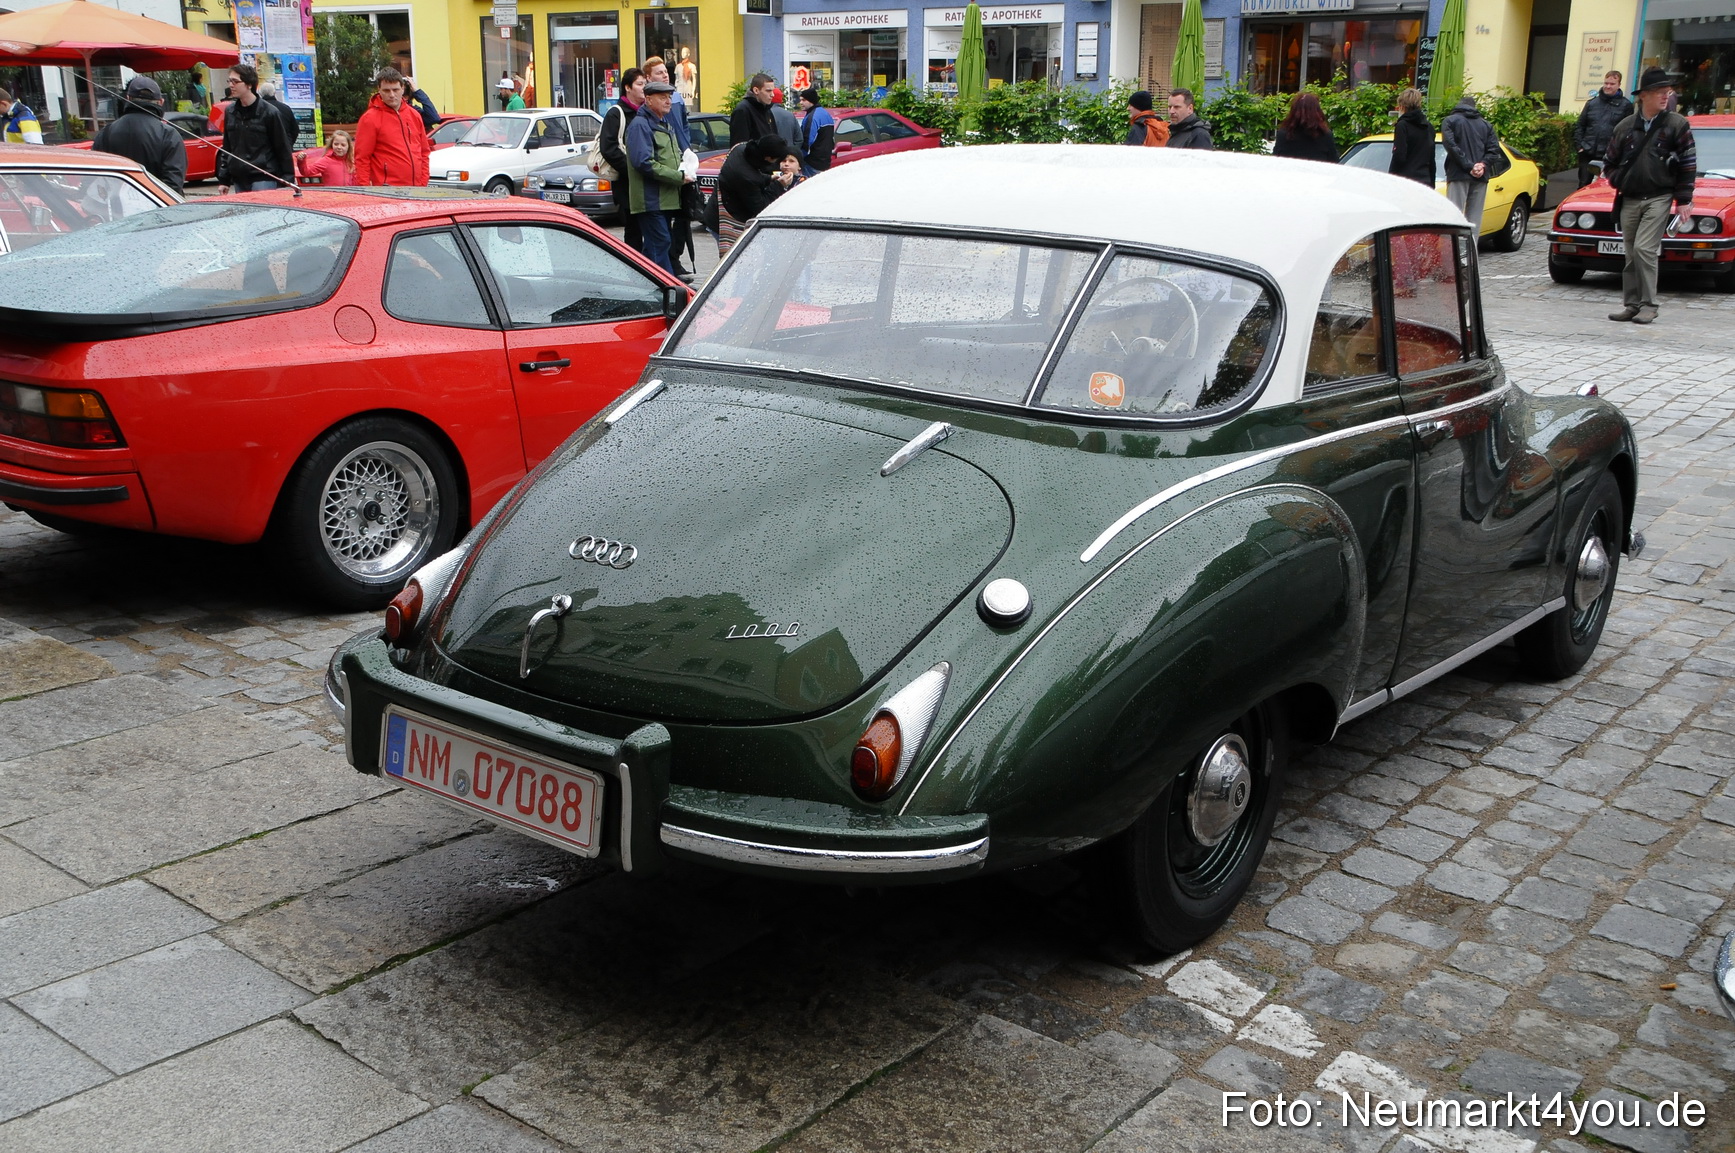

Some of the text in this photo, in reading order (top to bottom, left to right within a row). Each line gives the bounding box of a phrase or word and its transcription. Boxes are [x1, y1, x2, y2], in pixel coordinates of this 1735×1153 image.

[801, 14, 889, 26] RATHAUS APOTHEKE
[944, 9, 1042, 22] RATHS APOTHEKE
[1602, 242, 1619, 253] NM
[725, 621, 800, 639] 1000
[392, 750, 400, 764] D
[408, 728, 583, 832] NM 07088
